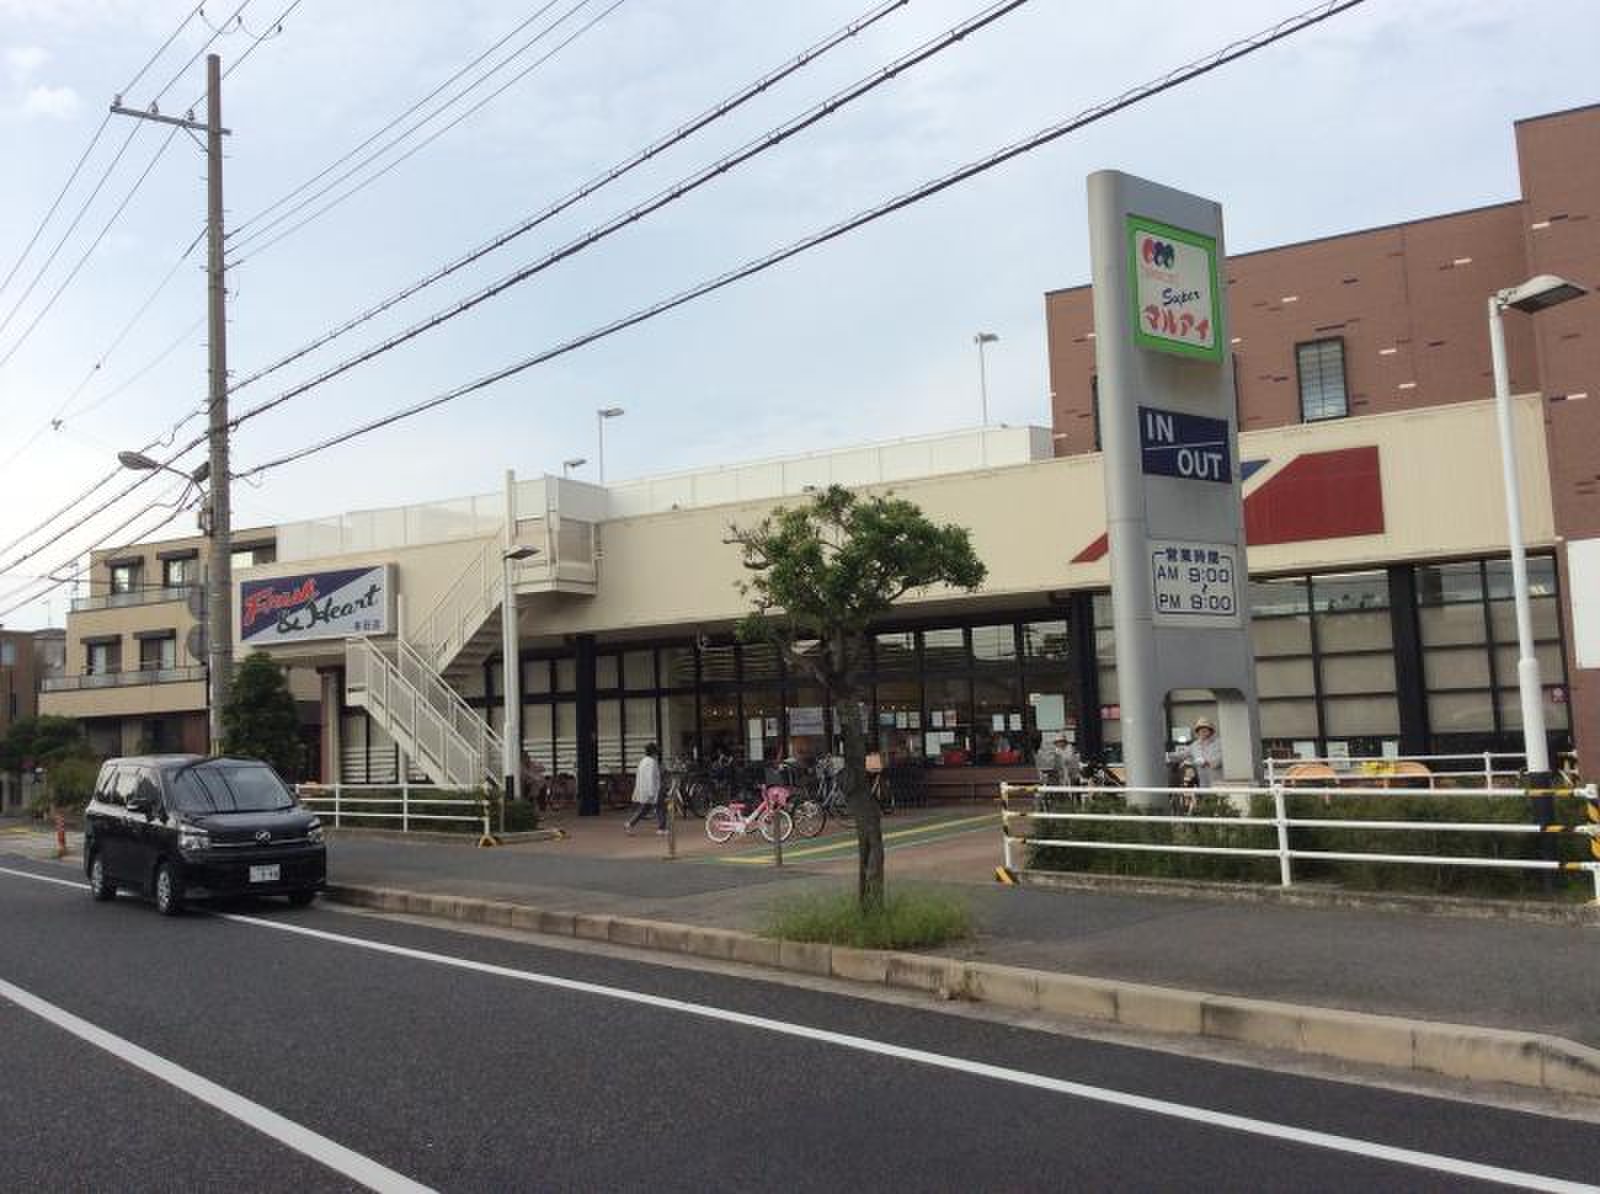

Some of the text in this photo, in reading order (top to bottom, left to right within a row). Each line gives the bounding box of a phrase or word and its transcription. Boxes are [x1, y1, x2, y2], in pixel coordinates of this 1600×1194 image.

[1162, 288, 1200, 306] Super
[1143, 304, 1210, 341] マルアイ
[1146, 413, 1174, 443] IN
[1177, 448, 1223, 480] OUT
[1157, 564, 1230, 583] AM 9:00
[305, 584, 382, 629] Heart
[1159, 593, 1181, 609] PM
